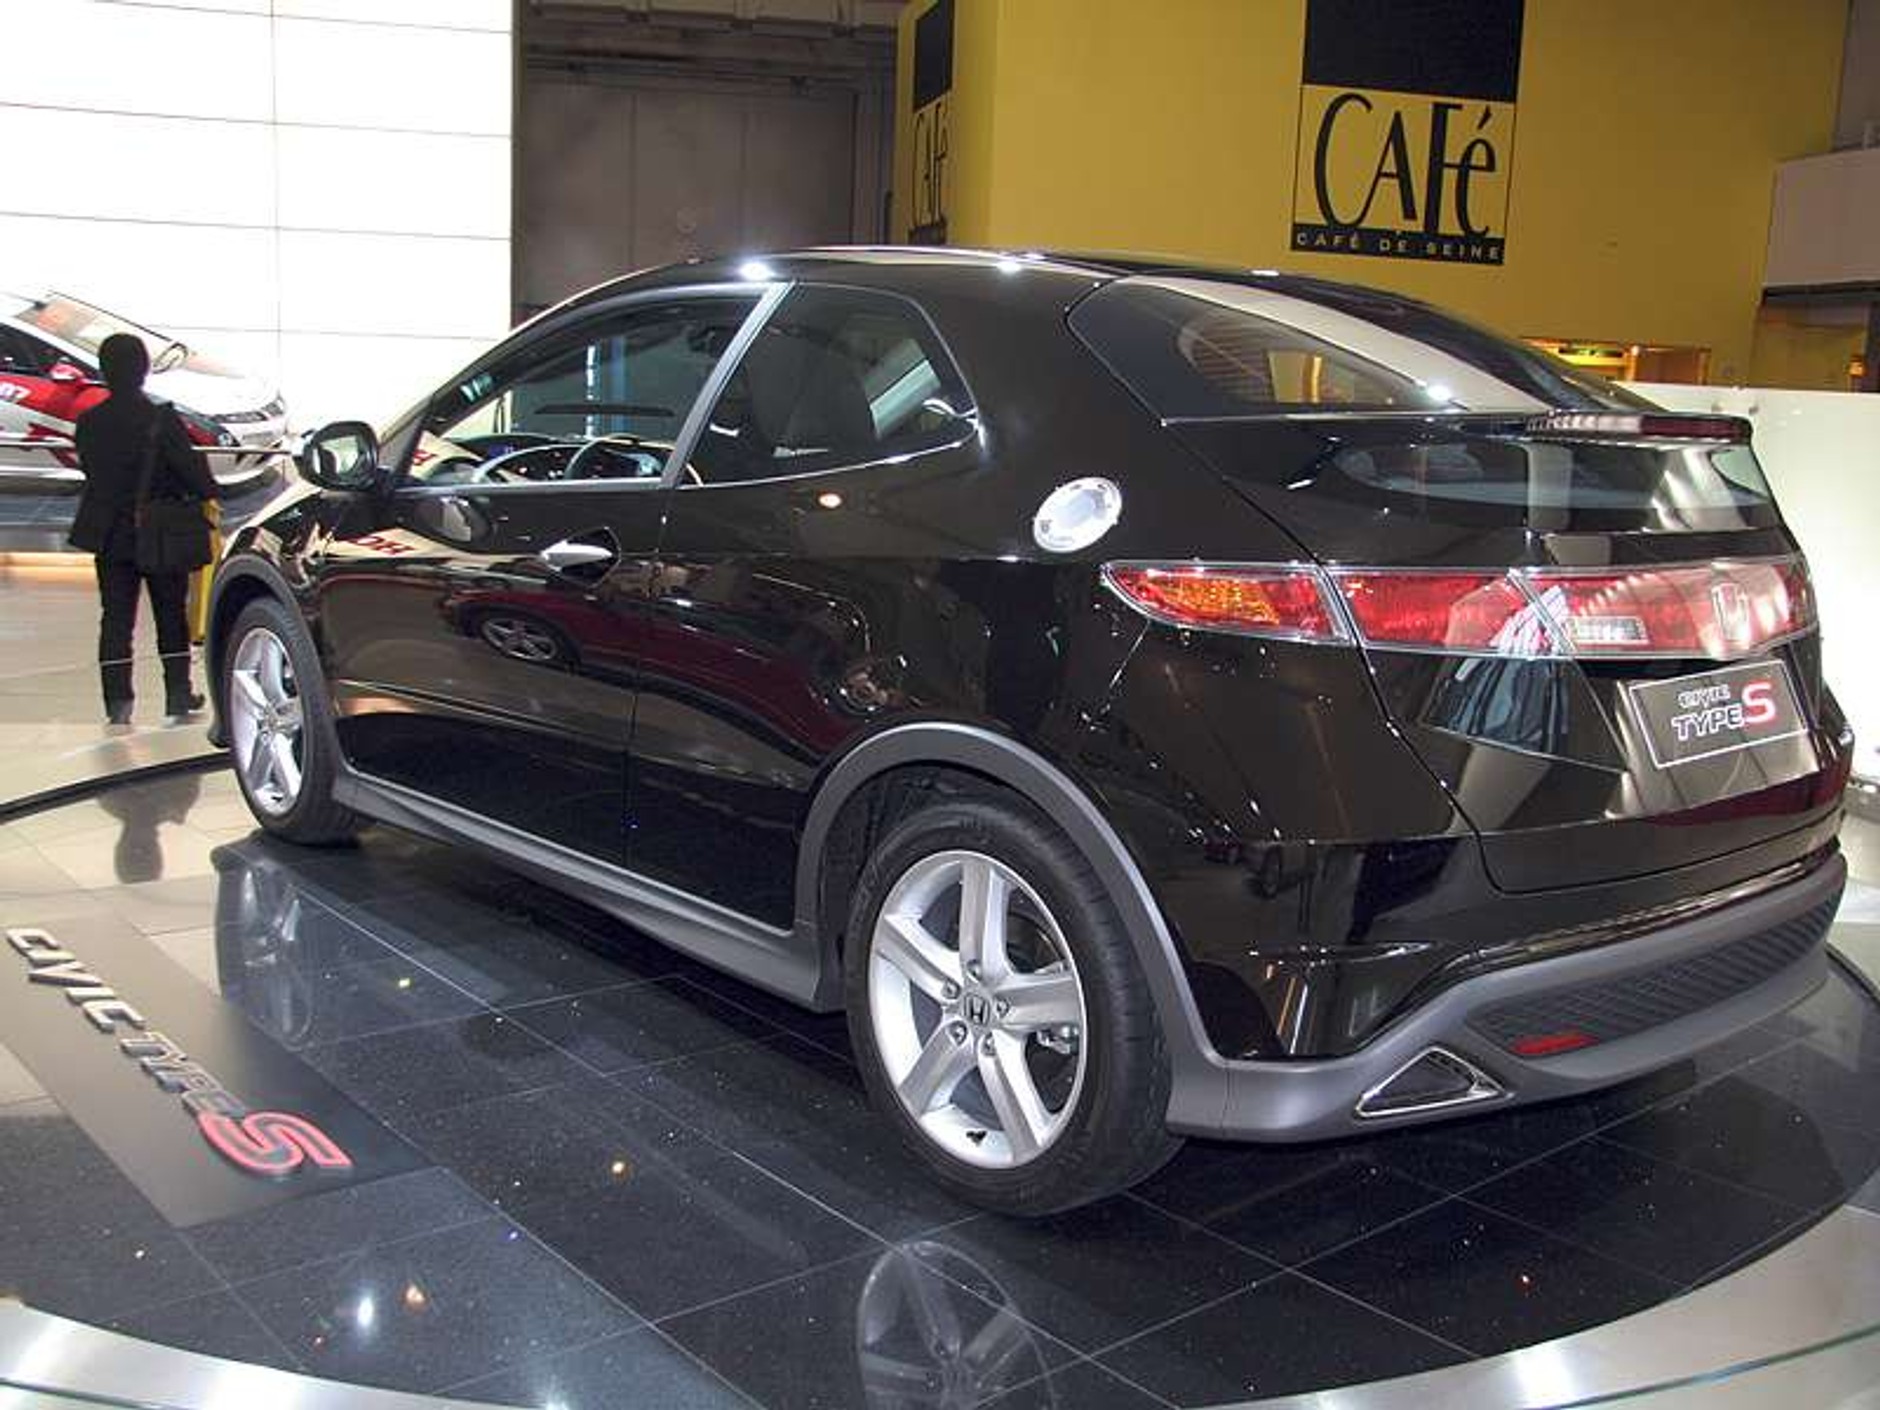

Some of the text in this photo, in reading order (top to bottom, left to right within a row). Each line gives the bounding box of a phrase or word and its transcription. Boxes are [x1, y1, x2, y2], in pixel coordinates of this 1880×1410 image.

[1379, 238, 1408, 253] DE
[1426, 242, 1500, 260] SEINE
[1671, 680, 1777, 741] TYPE S
[6, 928, 146, 1033] CIVIC
